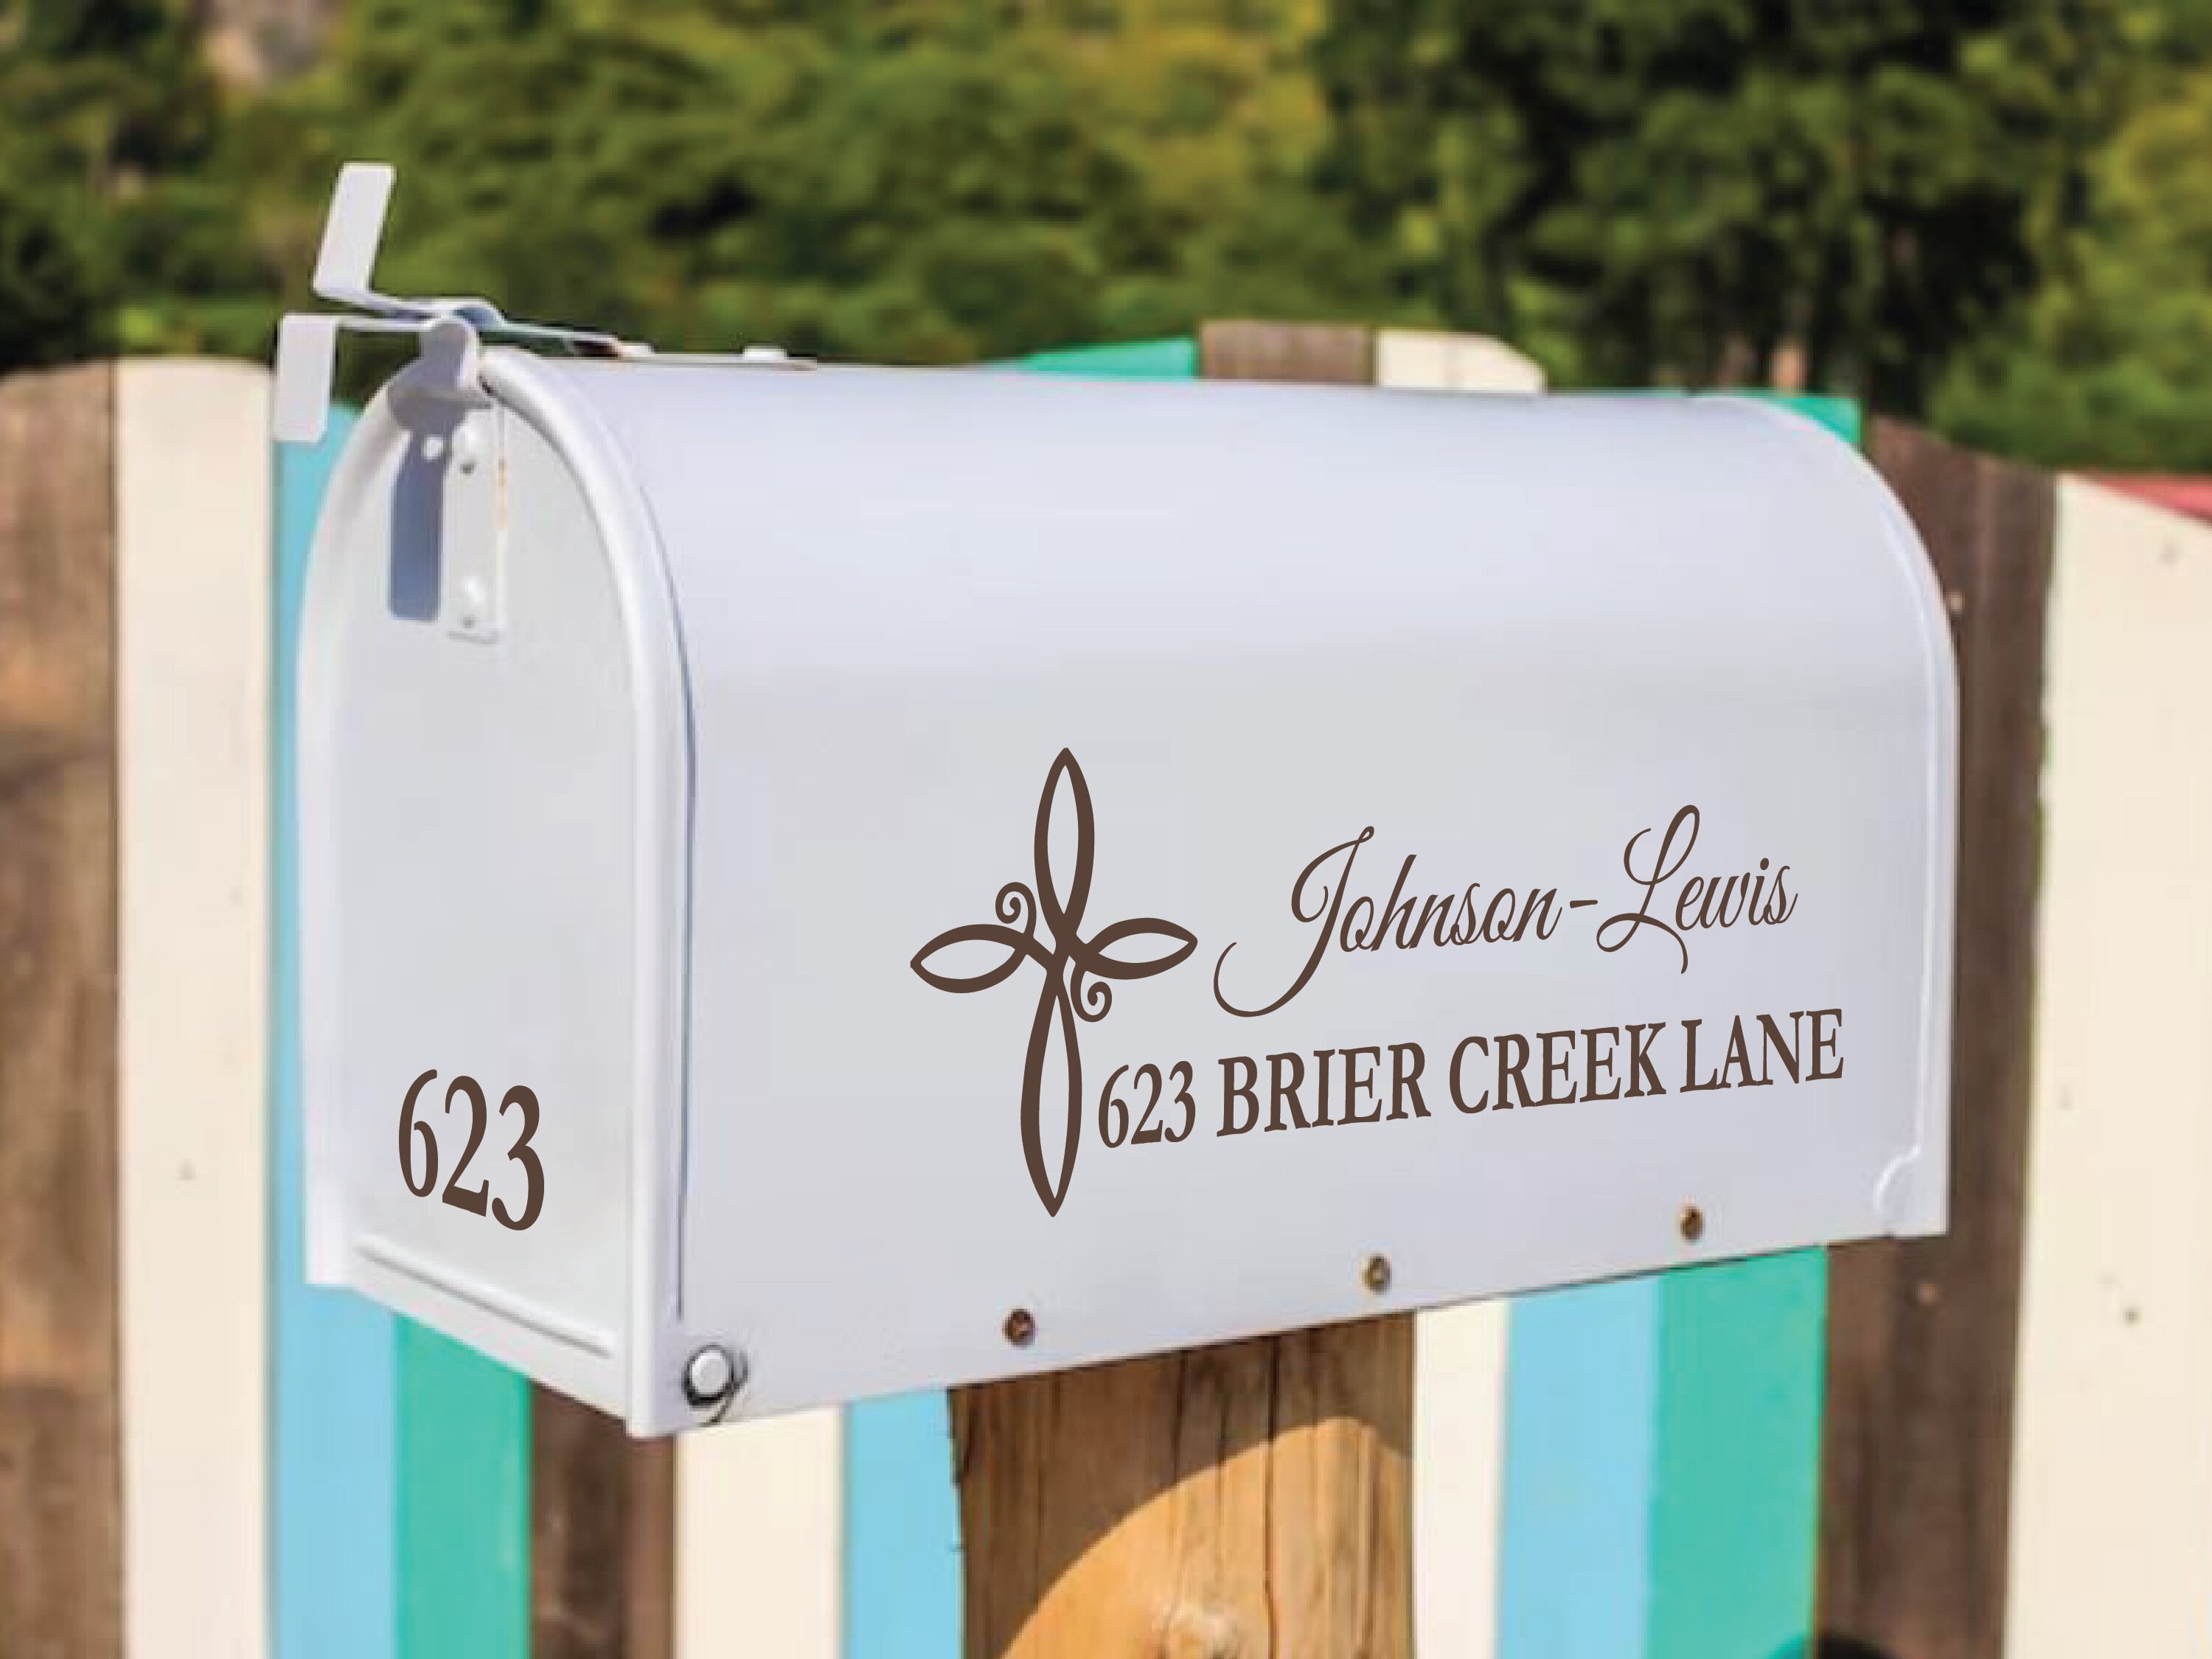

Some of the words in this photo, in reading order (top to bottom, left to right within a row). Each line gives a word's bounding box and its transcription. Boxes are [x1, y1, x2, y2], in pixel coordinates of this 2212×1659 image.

[1214, 804, 1798, 1018] Johnson-Lewis
[398, 1068, 545, 1231] 623
[1098, 1060, 1196, 1149] 623
[1216, 1042, 1432, 1138] BRIER
[1449, 1021, 1667, 1114] CREEK
[1680, 1008, 1845, 1093] LANE
